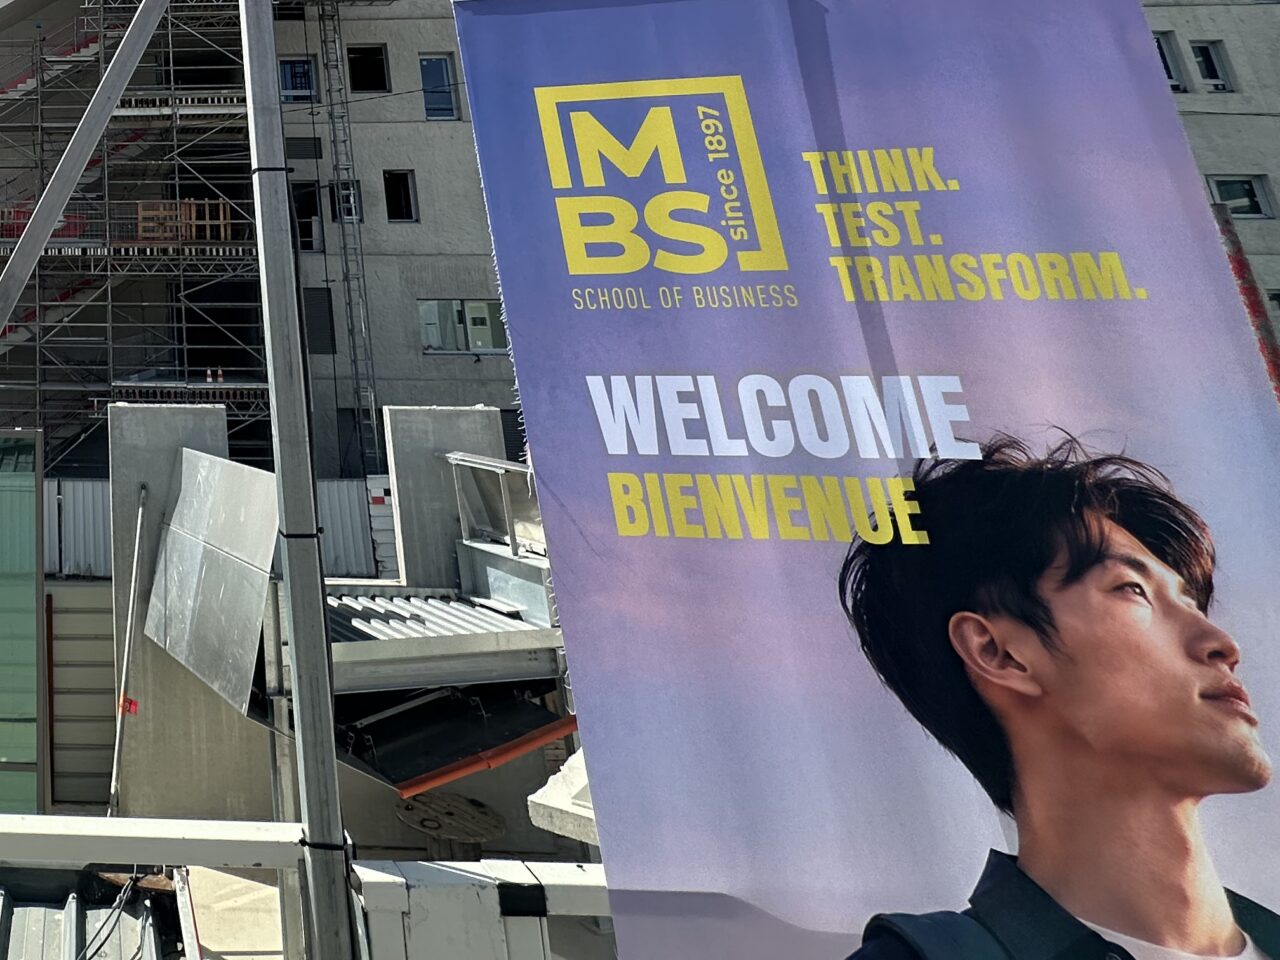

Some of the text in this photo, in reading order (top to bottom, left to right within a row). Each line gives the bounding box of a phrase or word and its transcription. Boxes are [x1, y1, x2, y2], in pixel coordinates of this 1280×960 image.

[697, 105, 748, 241] since 1897
[801, 147, 960, 195] THINK.
[815, 200, 943, 248] TEST.
[572, 284, 799, 310] SCHOOL OF BUSINESS
[828, 251, 1149, 302] TRANSFORM.
[585, 374, 983, 461] WELCOME
[607, 472, 930, 546] BIENVENUE
